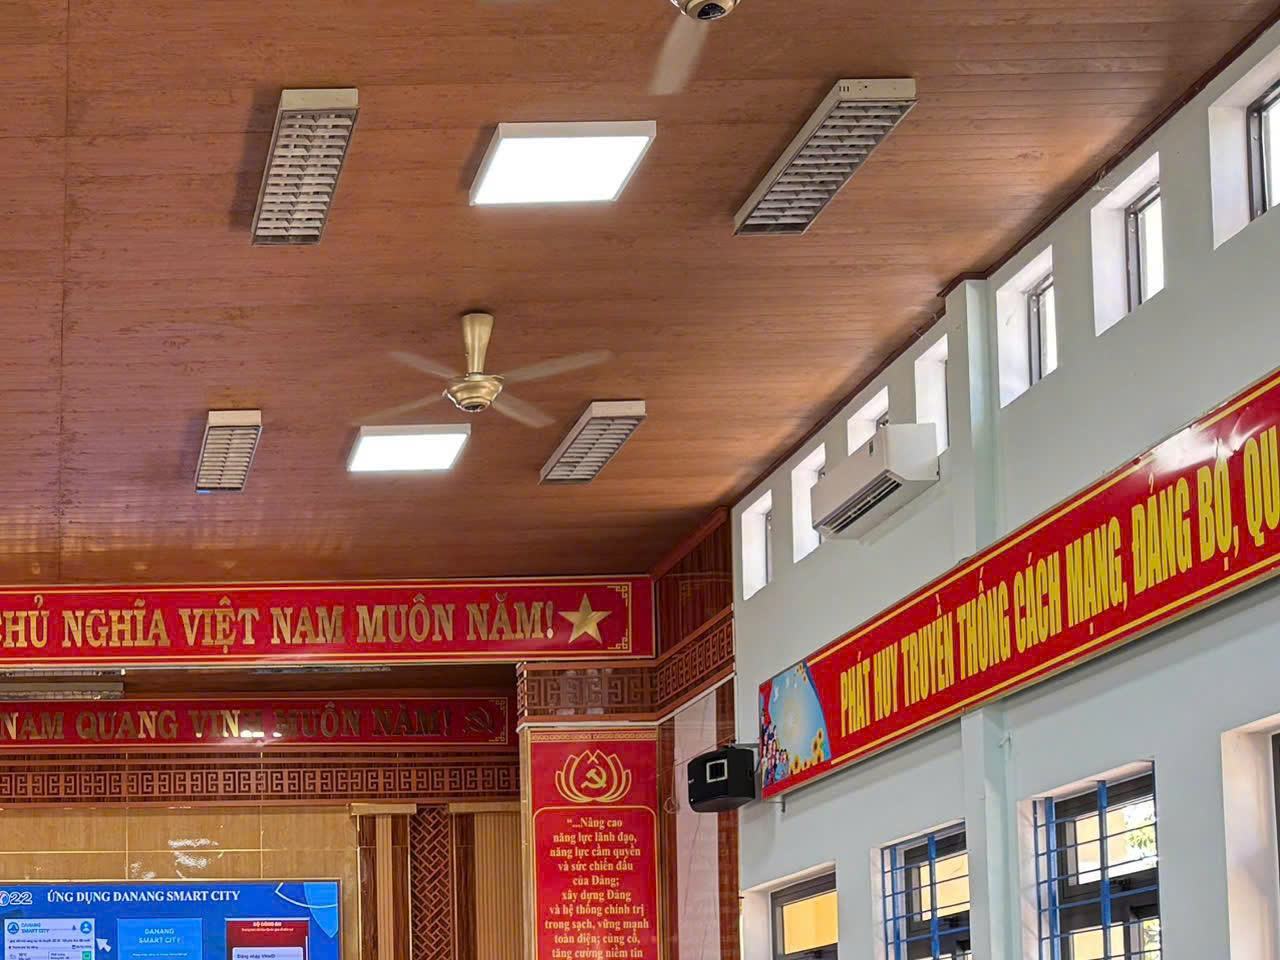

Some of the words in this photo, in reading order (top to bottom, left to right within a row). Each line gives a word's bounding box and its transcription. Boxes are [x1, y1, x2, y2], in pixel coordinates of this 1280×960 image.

[61, 600, 169, 647] NGHĨA
[179, 595, 259, 655] VIỆT
[270, 604, 344, 645] NAM
[356, 593, 456, 643] MUÔN
[466, 592, 554, 641] NĂM!
[840, 651, 871, 738] PHÁT
[873, 641, 898, 722] HUY
[901, 593, 955, 707] TRUYỀN
[957, 566, 1010, 680] THỐNG
[1013, 551, 1062, 654] CÁCH
[1065, 516, 1128, 634] MẠNG,
[1131, 471, 1192, 595] ĐẢNG
[76, 709, 179, 741] QUANG
[372, 703, 452, 737] NĂM!
[47, 890, 73, 902] ỨNG
[76, 892, 111, 904] DỤNG
[113, 892, 164, 901] DANANG
[167, 891, 209, 901] SMART
[211, 890, 240, 901] CITY
